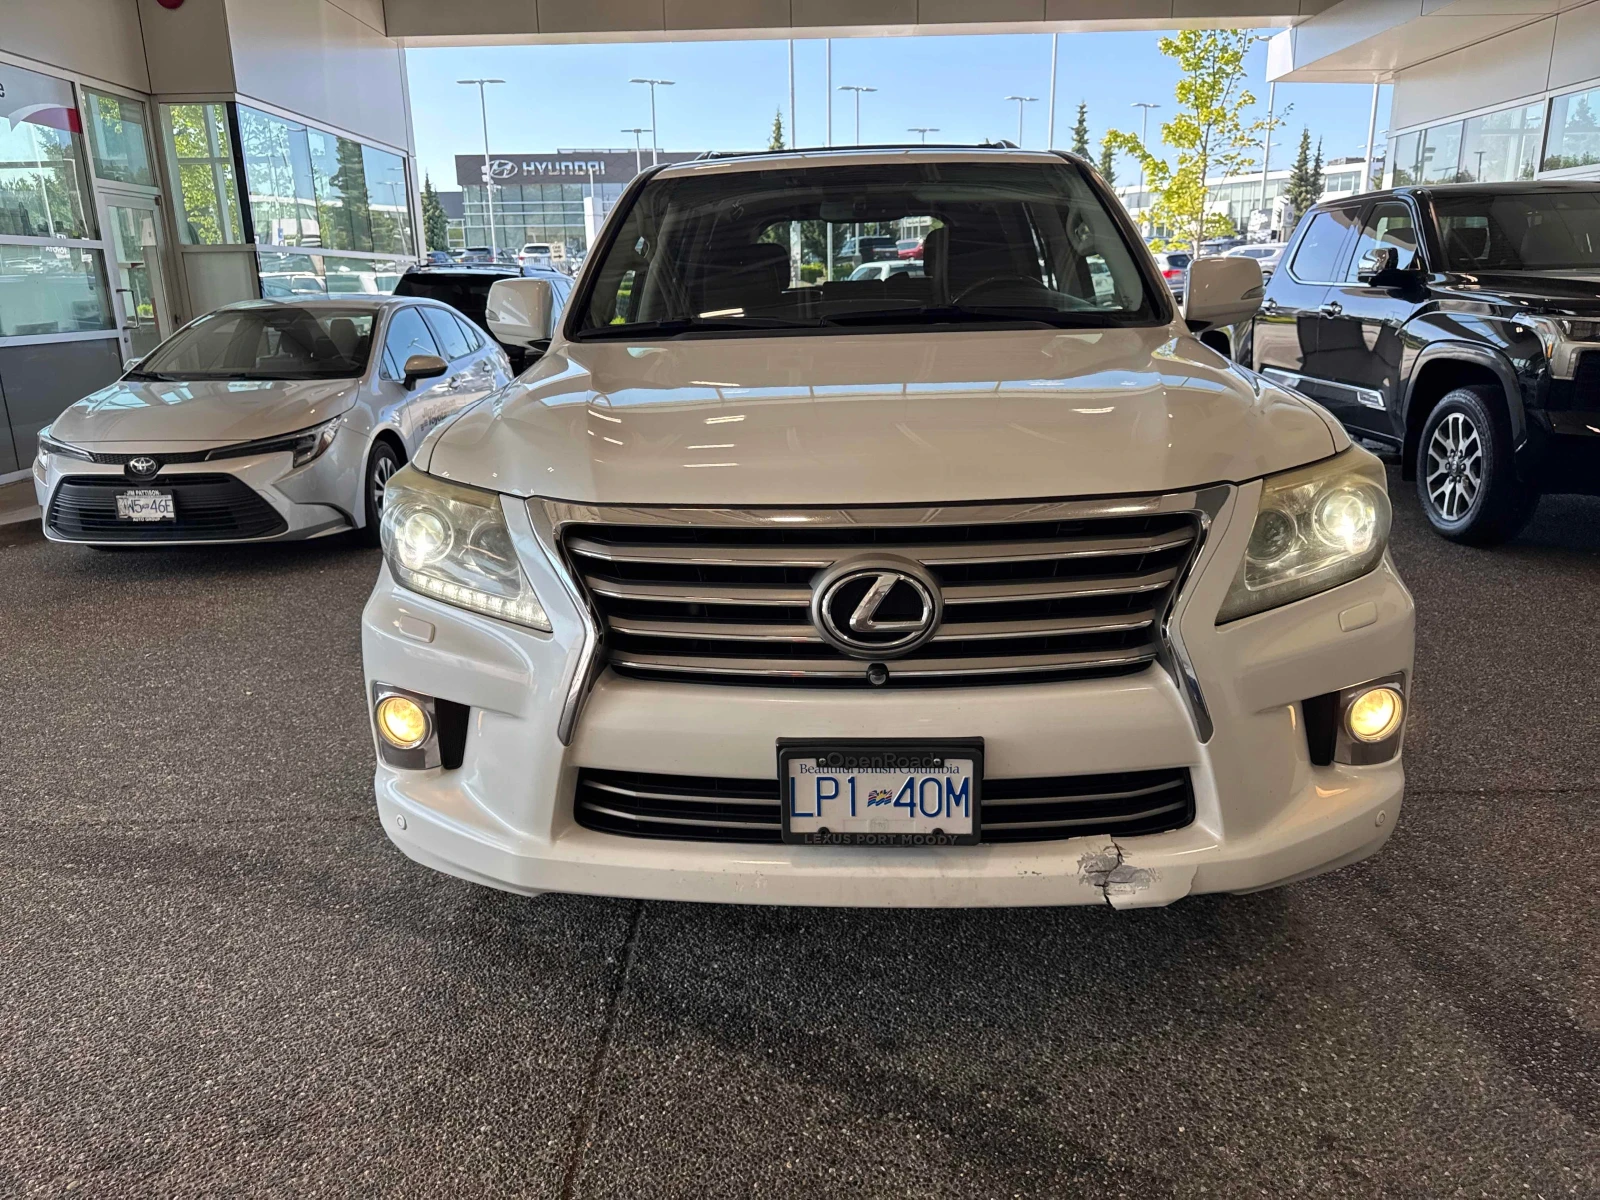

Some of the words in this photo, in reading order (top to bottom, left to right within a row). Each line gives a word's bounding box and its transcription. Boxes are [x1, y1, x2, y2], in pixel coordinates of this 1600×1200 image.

[522, 161, 606, 176] HYUNDAI
[150, 499, 174, 514] 46E
[826, 751, 935, 769] OpenRoad
[790, 776, 856, 818] LP1
[893, 776, 971, 818] 40M
[804, 834, 851, 845] LEXUS
[856, 834, 896, 845] PORT
[901, 835, 958, 846] MOODY
